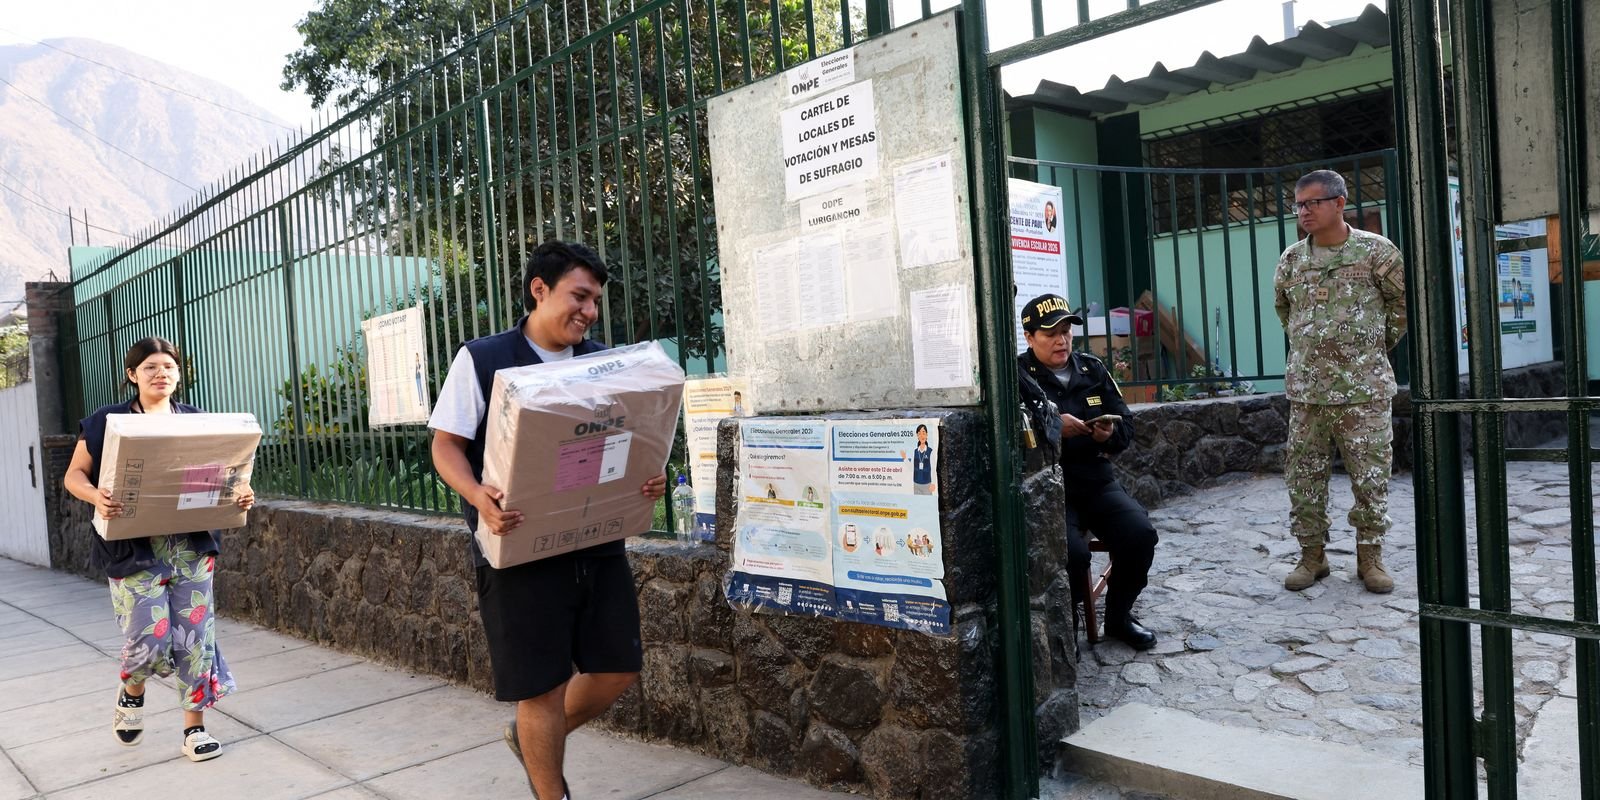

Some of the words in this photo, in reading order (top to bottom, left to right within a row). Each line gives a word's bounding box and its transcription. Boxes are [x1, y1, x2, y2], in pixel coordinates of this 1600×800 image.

[821, 54, 849, 68] Elecciones
[822, 63, 848, 75] Generales
[791, 77, 820, 95] ONPE
[800, 100, 835, 121] CARTEL
[836, 94, 850, 108] DE
[798, 120, 840, 143] LOCALES
[841, 115, 855, 129] DE
[784, 144, 830, 168] VOTACIÓN
[832, 142, 838, 153] Y
[840, 131, 876, 151] MESAS
[799, 172, 812, 185] DE
[813, 157, 863, 180] SUFRAGIO
[822, 198, 844, 210] ODPE
[808, 208, 860, 227] LURIGANCHO
[1010, 216, 1024, 226] CENTE
[1025, 218, 1031, 227] DE
[1012, 237, 1031, 249] VIVENCIA
[1031, 239, 1048, 251] ESCOLAR
[587, 359, 625, 375] ONPE
[574, 415, 626, 436] ONPE
[869, 430, 900, 438] Generales
[900, 430, 914, 438] 2026
